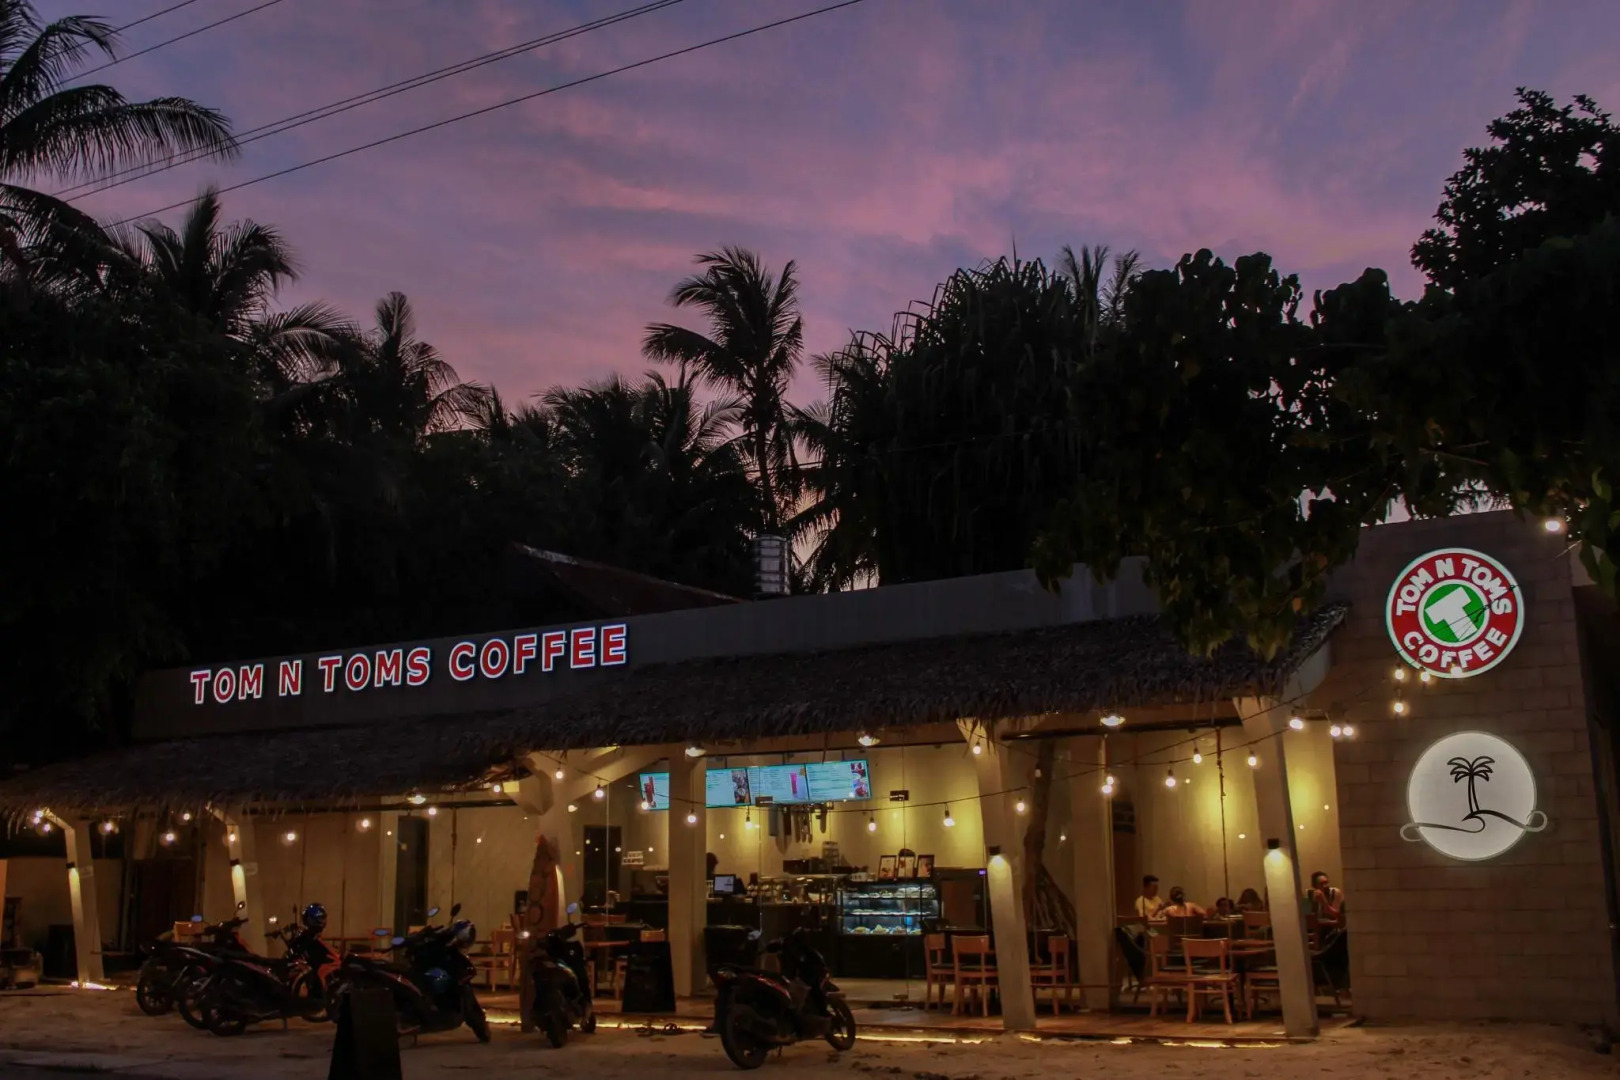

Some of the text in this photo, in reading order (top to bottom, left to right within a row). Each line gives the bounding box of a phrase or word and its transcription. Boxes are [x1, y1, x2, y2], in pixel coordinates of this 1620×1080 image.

[1396, 558, 1512, 668] TOM N TOMS COFFEE
[190, 624, 627, 704] TOM N TOMS COFFEE
